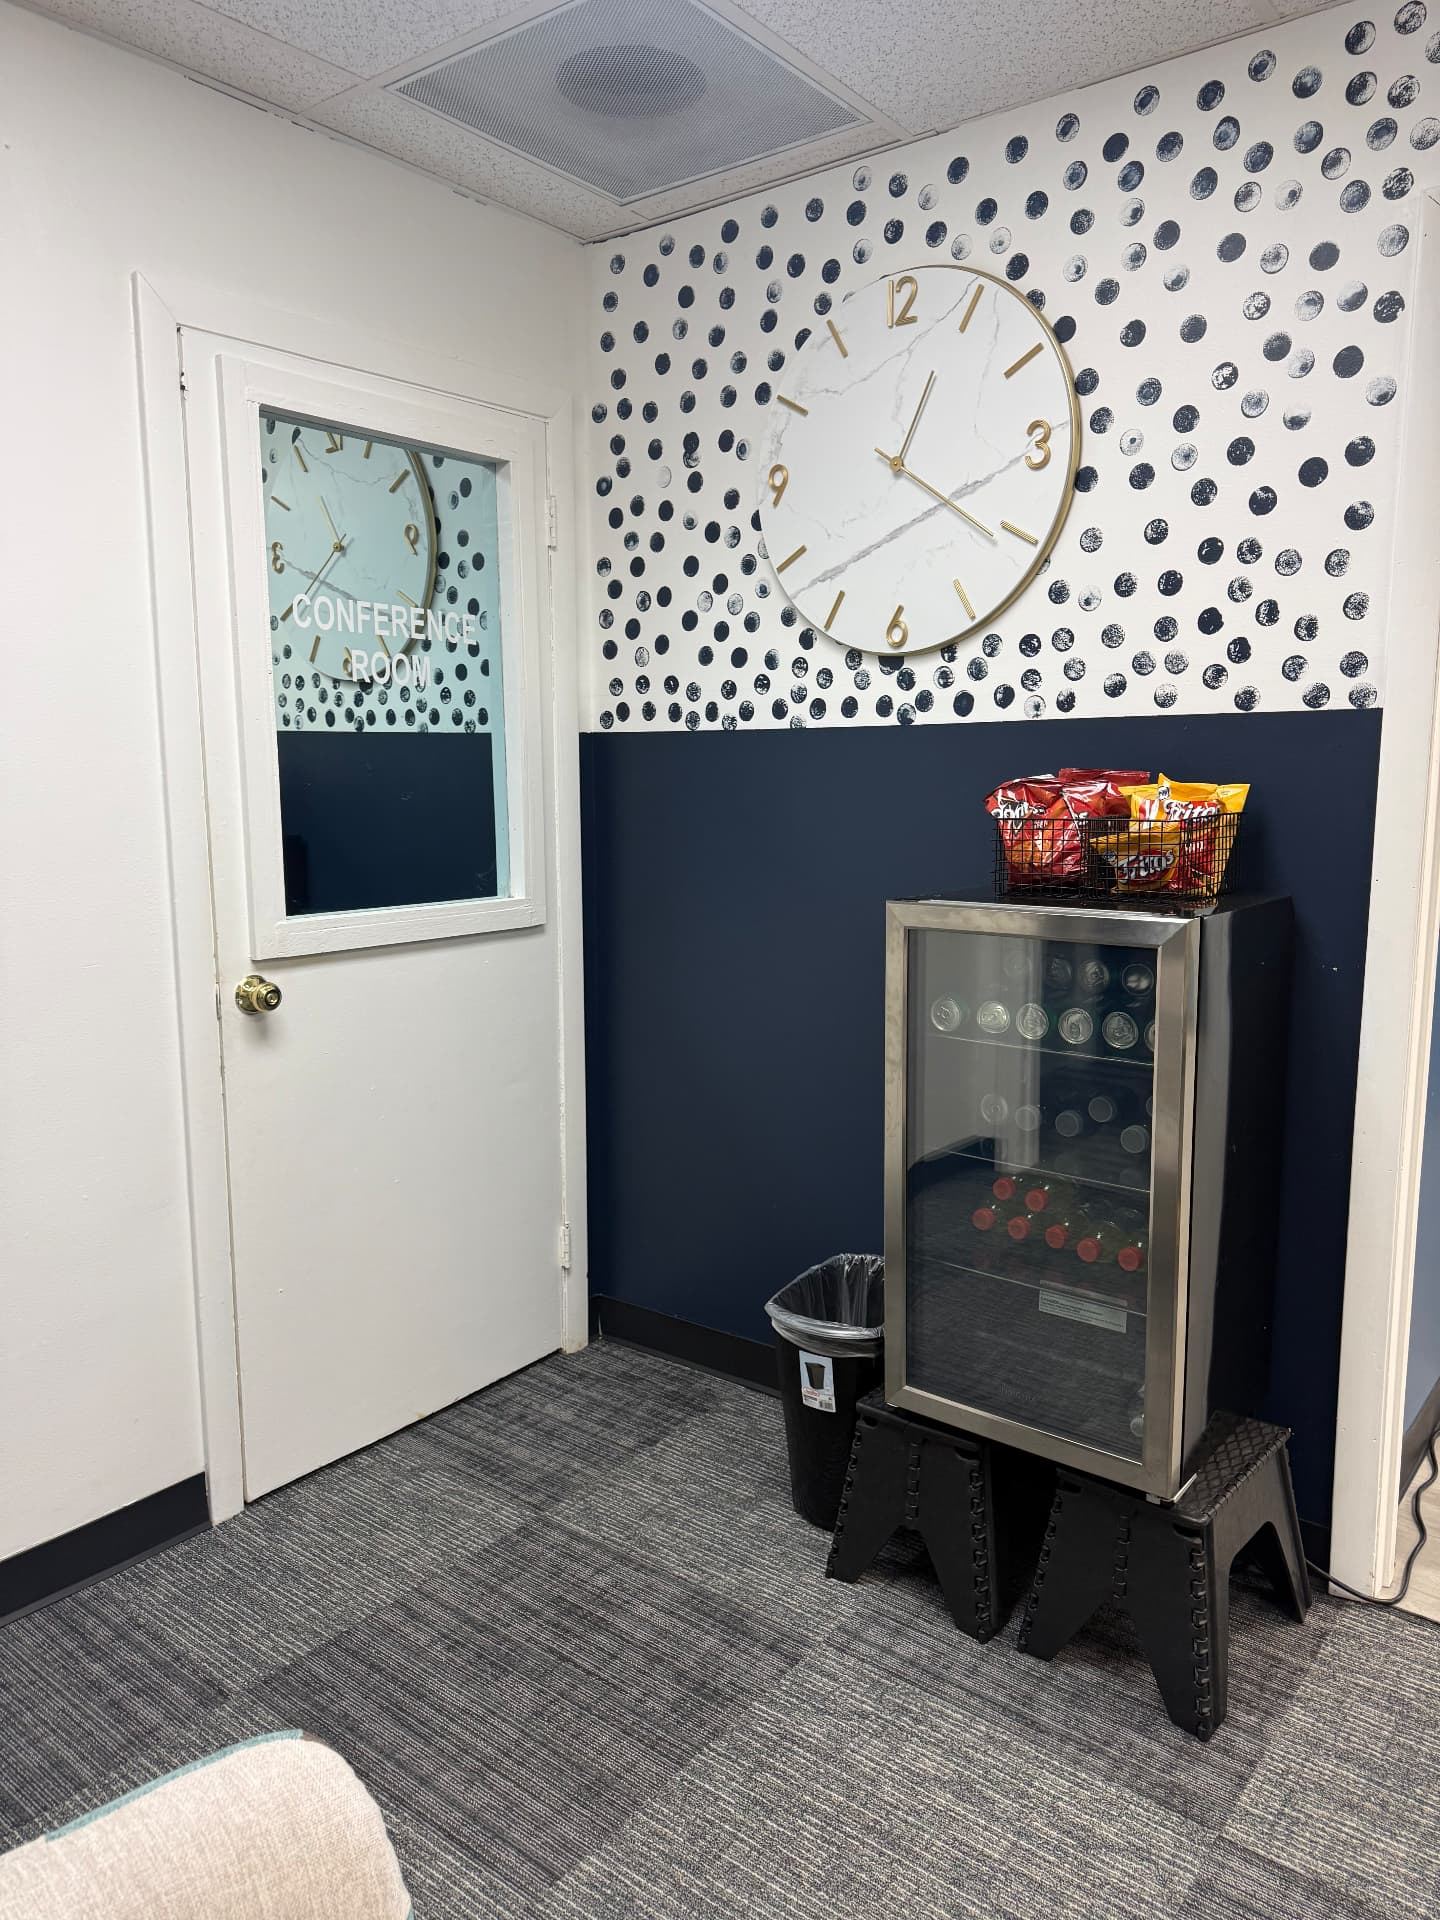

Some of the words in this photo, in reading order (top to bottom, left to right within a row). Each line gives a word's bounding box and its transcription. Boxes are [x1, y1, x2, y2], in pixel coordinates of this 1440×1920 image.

[886, 276, 918, 328] 12
[1024, 420, 1051, 471] 3
[767, 463, 789, 508] 9
[292, 593, 477, 646] CONFERENCE
[886, 604, 908, 647] 6
[351, 649, 432, 687] ROOM
